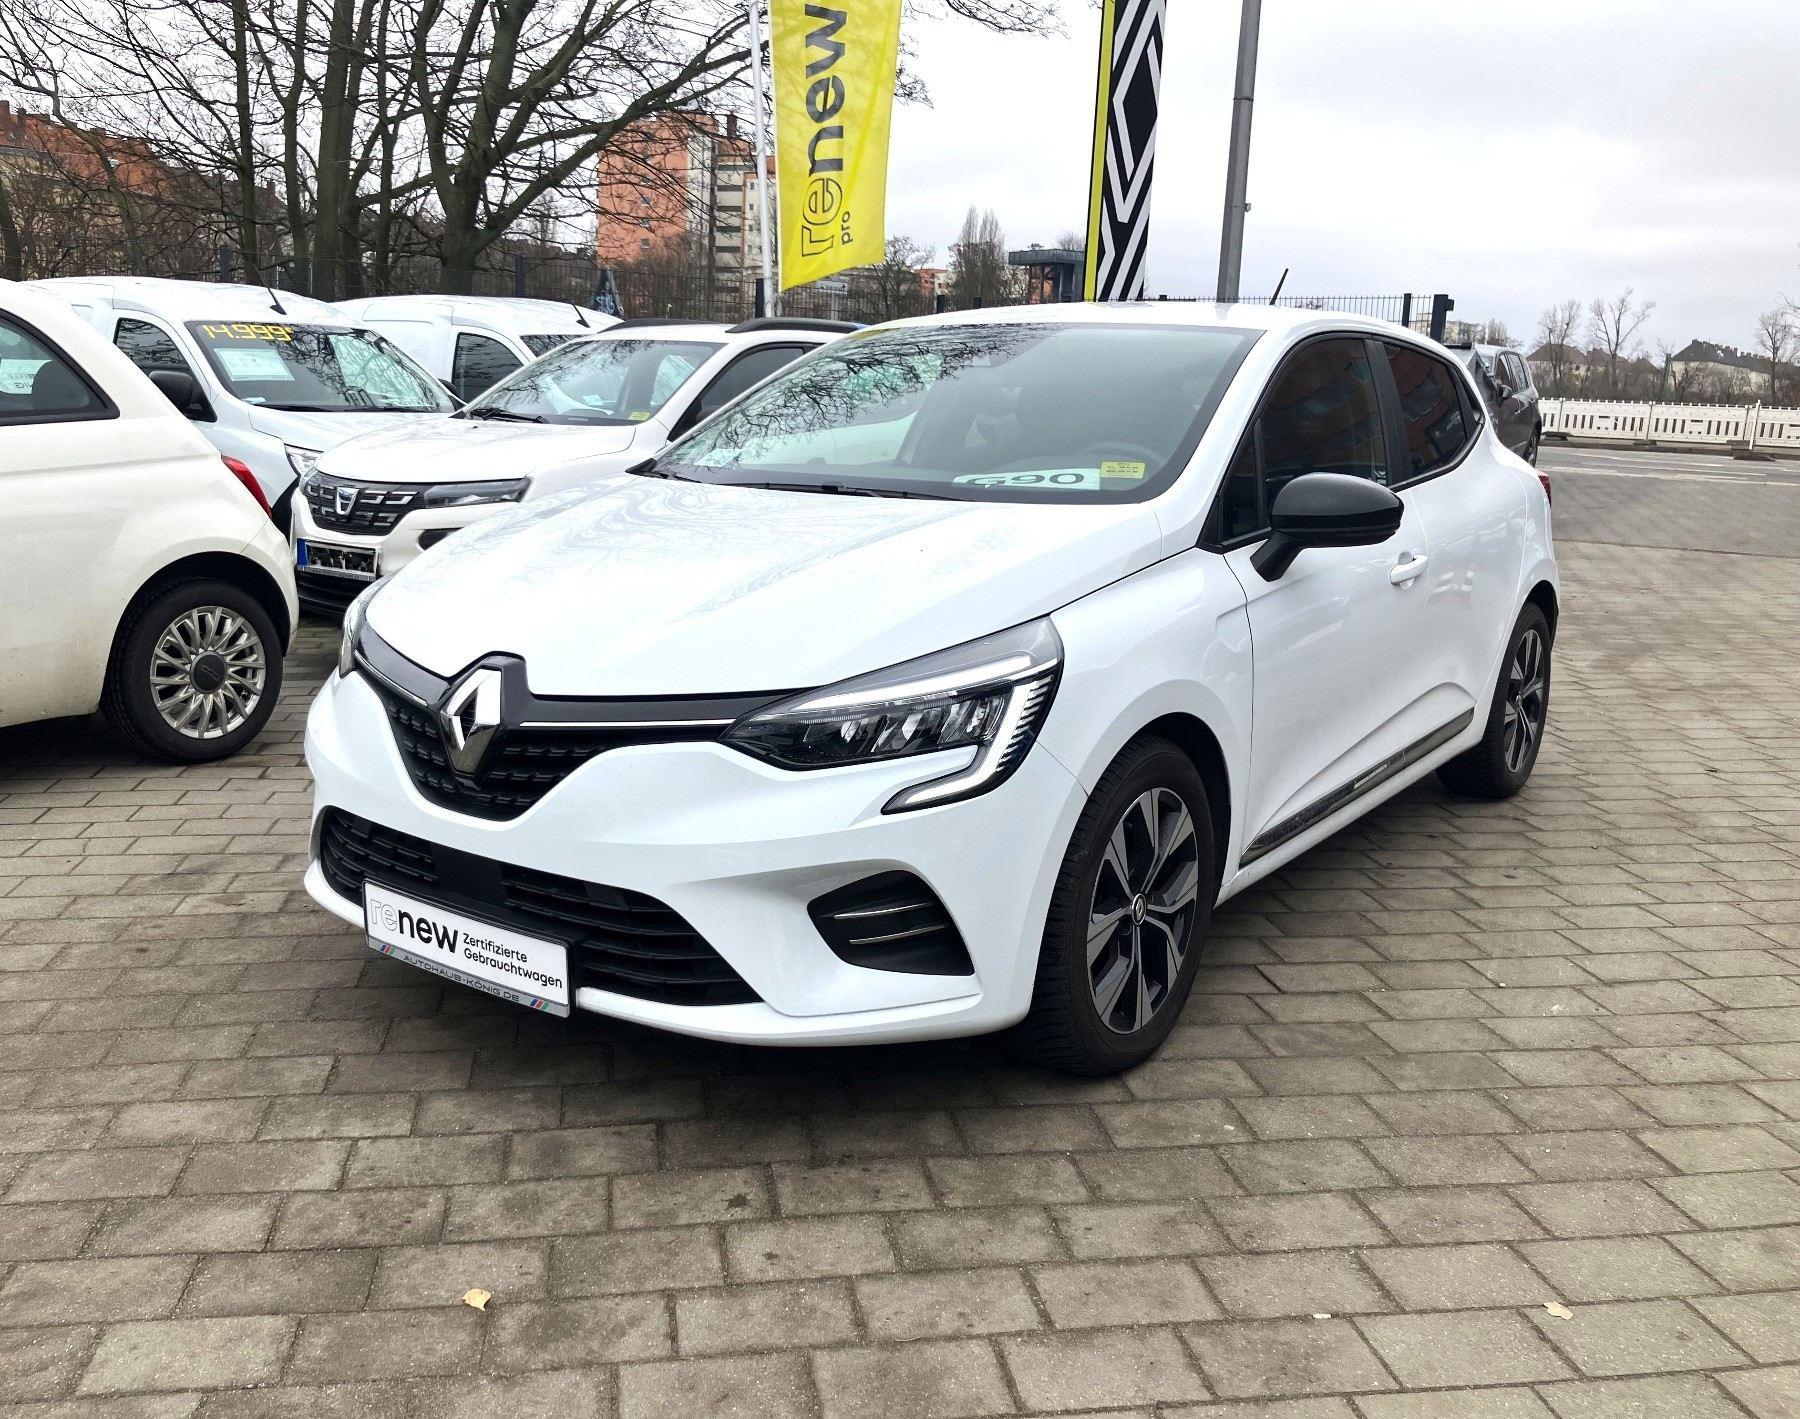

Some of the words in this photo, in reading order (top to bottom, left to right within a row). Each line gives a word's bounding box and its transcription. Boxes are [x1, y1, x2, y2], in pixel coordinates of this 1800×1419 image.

[801, 3, 848, 257] renew
[841, 211, 853, 245] pro
[369, 898, 459, 954] renew
[463, 932, 528, 963] Zertifizierte
[463, 947, 563, 989] Gebrauchtwagen
